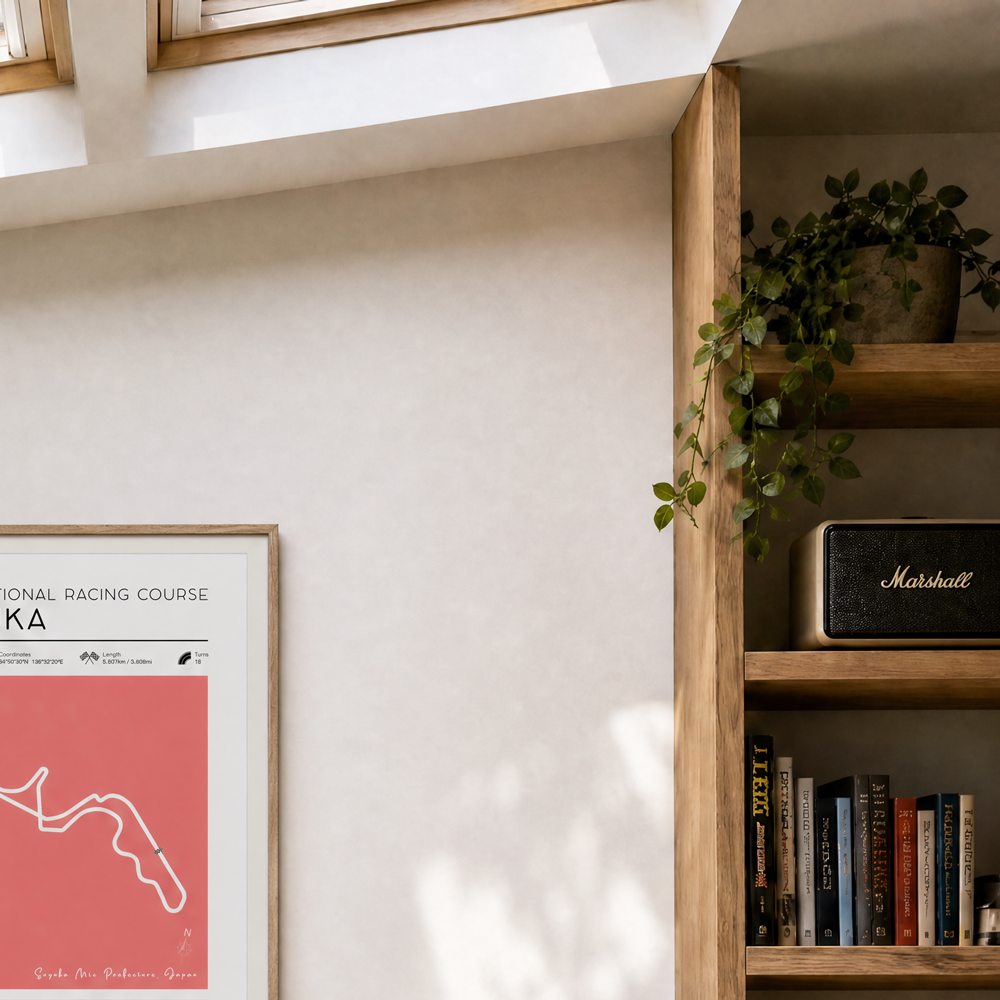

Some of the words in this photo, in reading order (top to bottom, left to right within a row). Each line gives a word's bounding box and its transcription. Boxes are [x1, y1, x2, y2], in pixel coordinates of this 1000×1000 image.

[880, 565, 974, 589] Marshall
[64, 588, 130, 601] RACING
[138, 588, 208, 601] COURSE
[184, 928, 192, 937] N
